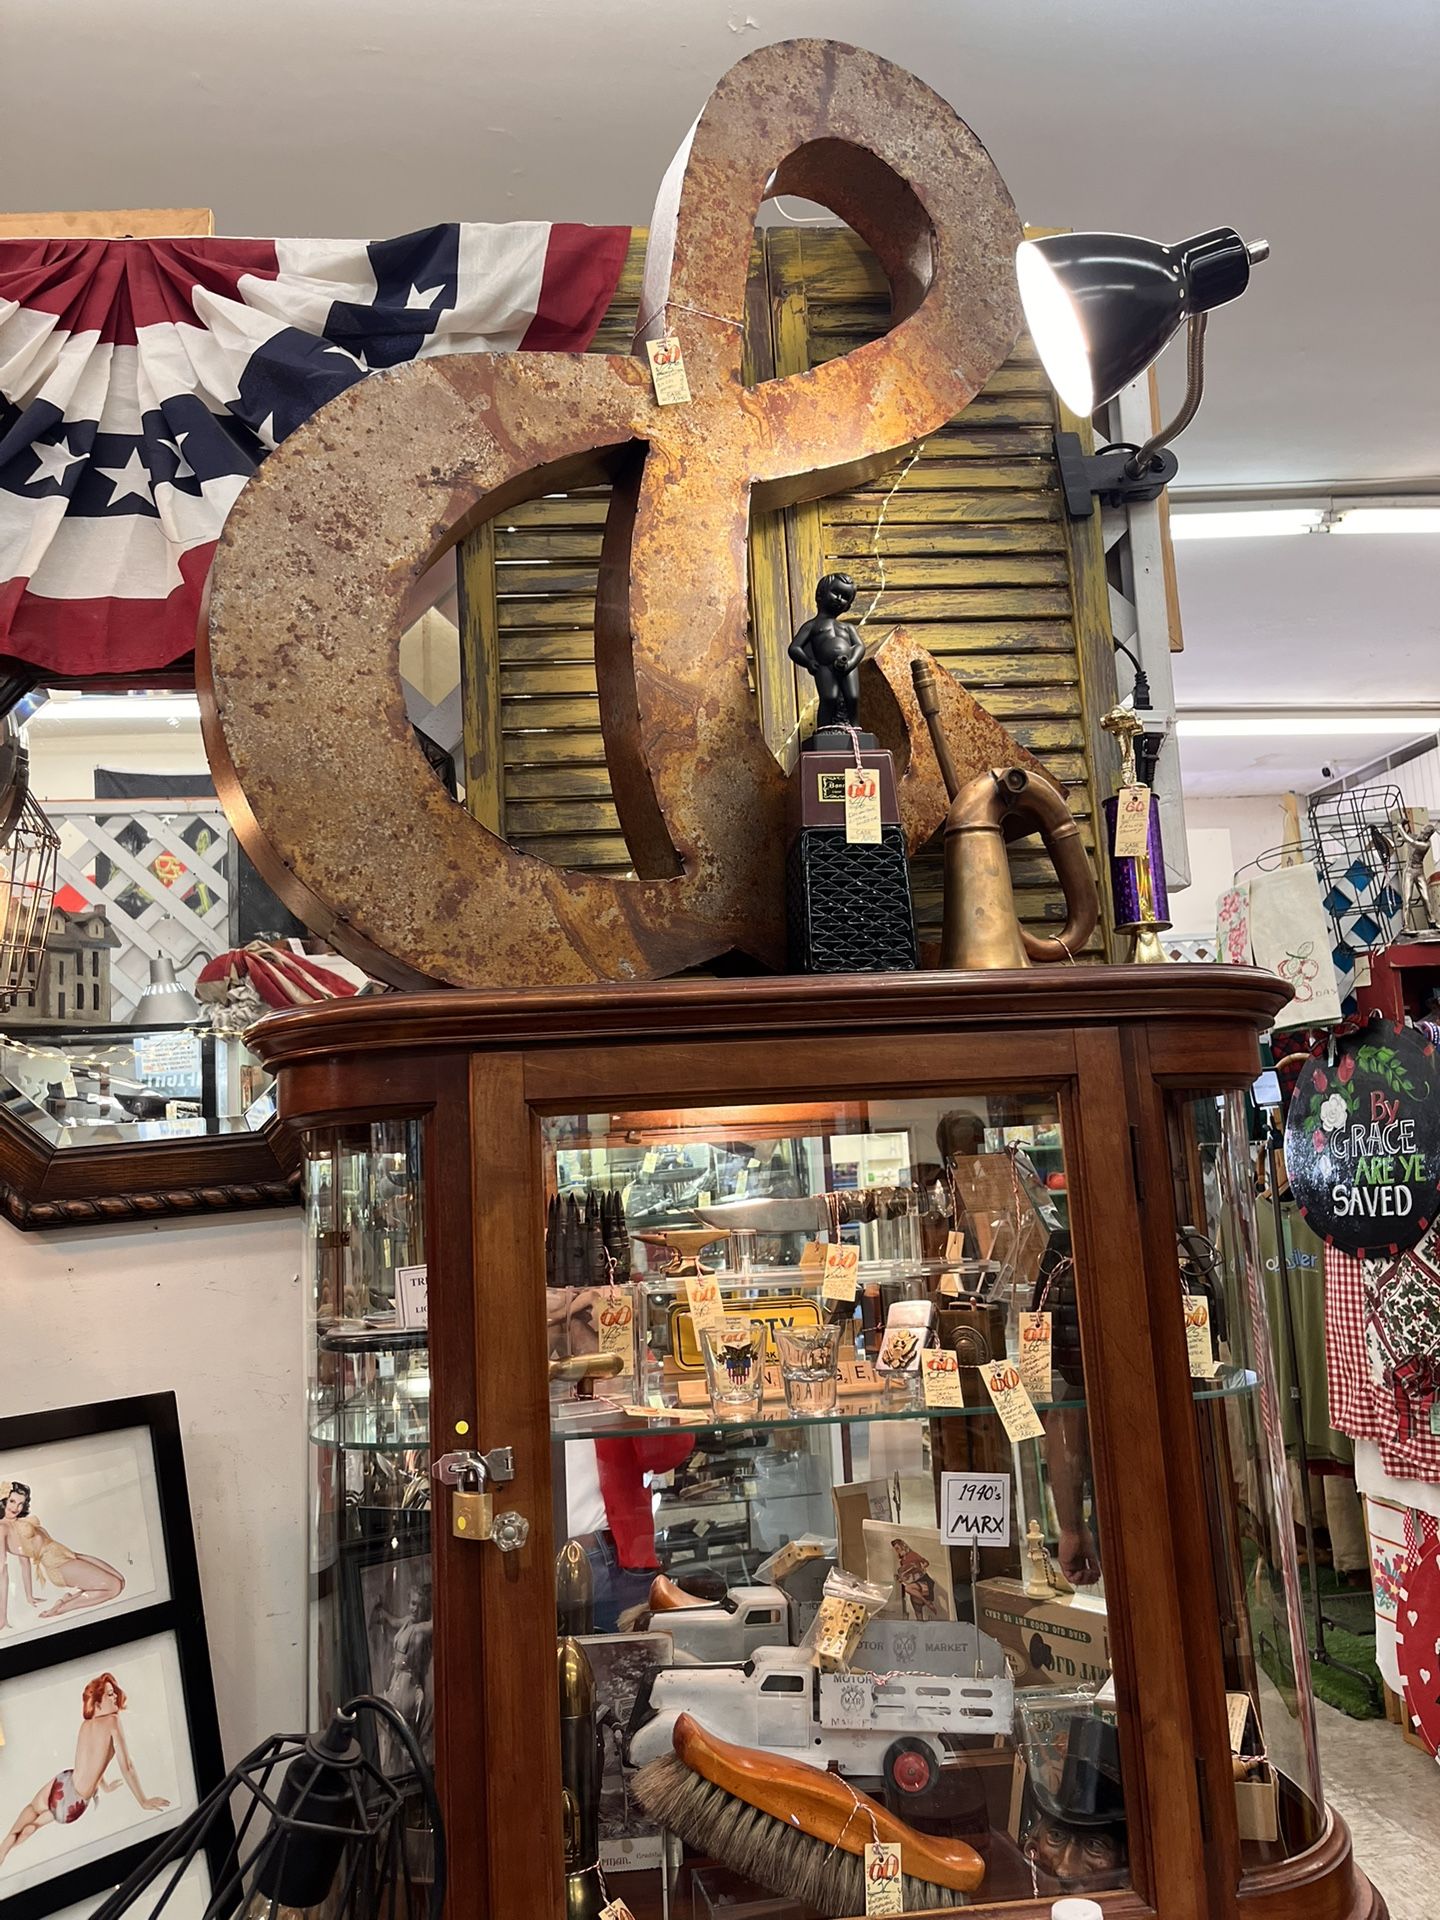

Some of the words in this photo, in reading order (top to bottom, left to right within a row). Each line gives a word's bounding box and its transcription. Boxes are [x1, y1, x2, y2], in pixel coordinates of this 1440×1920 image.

[1370, 1090, 1400, 1125] By
[1330, 1120, 1417, 1159] GRACE
[1353, 1155, 1396, 1186] ARE
[1401, 1153, 1427, 1183] YE
[1332, 1184, 1414, 1218] SAVED
[958, 1483, 1002, 1502] 1940's
[950, 1514, 1005, 1535] MARX
[925, 1643, 968, 1653] MARKET
[832, 1674, 873, 1685] MOTOR
